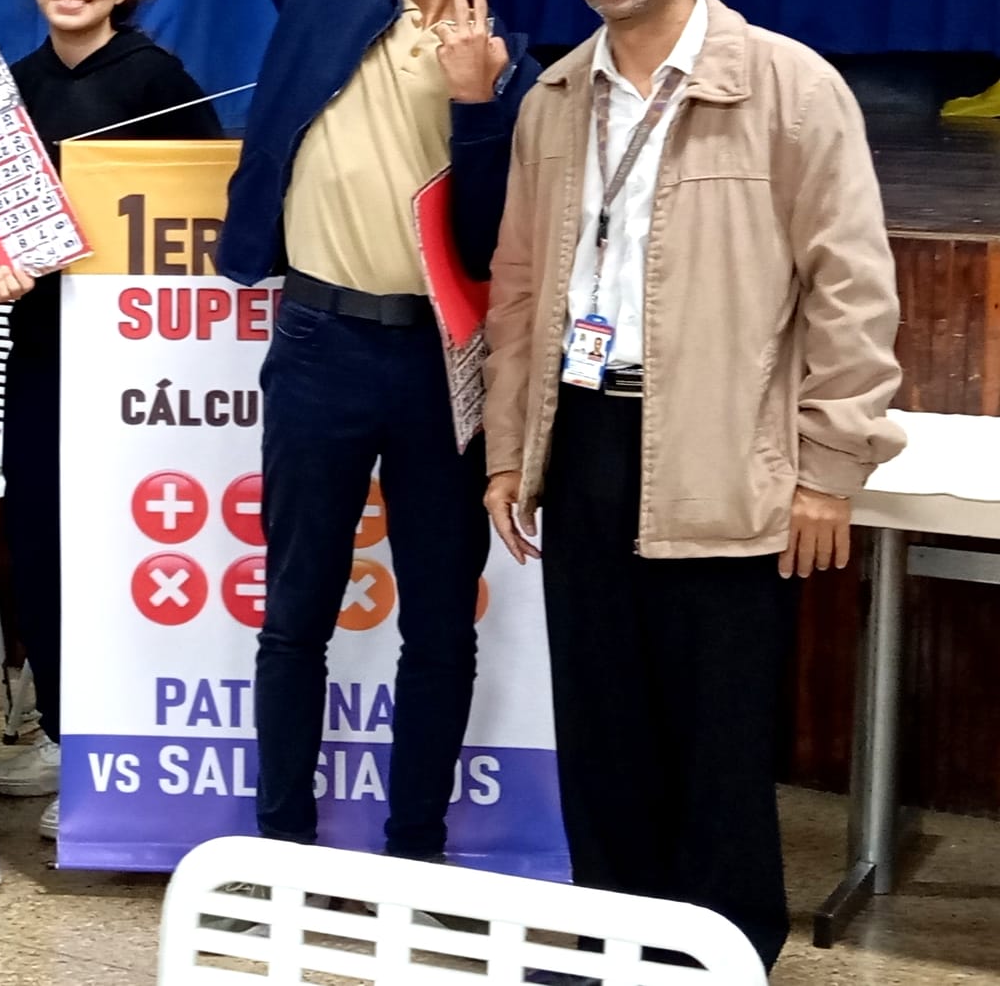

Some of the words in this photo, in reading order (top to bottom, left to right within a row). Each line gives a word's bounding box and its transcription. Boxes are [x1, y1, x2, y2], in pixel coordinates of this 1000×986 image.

[2, 165, 19, 177] 24
[22, 205, 39, 217] 14
[118, 287, 282, 341] SUPE
[121, 378, 259, 427] CÁLCU
[155, 677, 395, 732] PATNA
[158, 745, 501, 805] SALIAS
